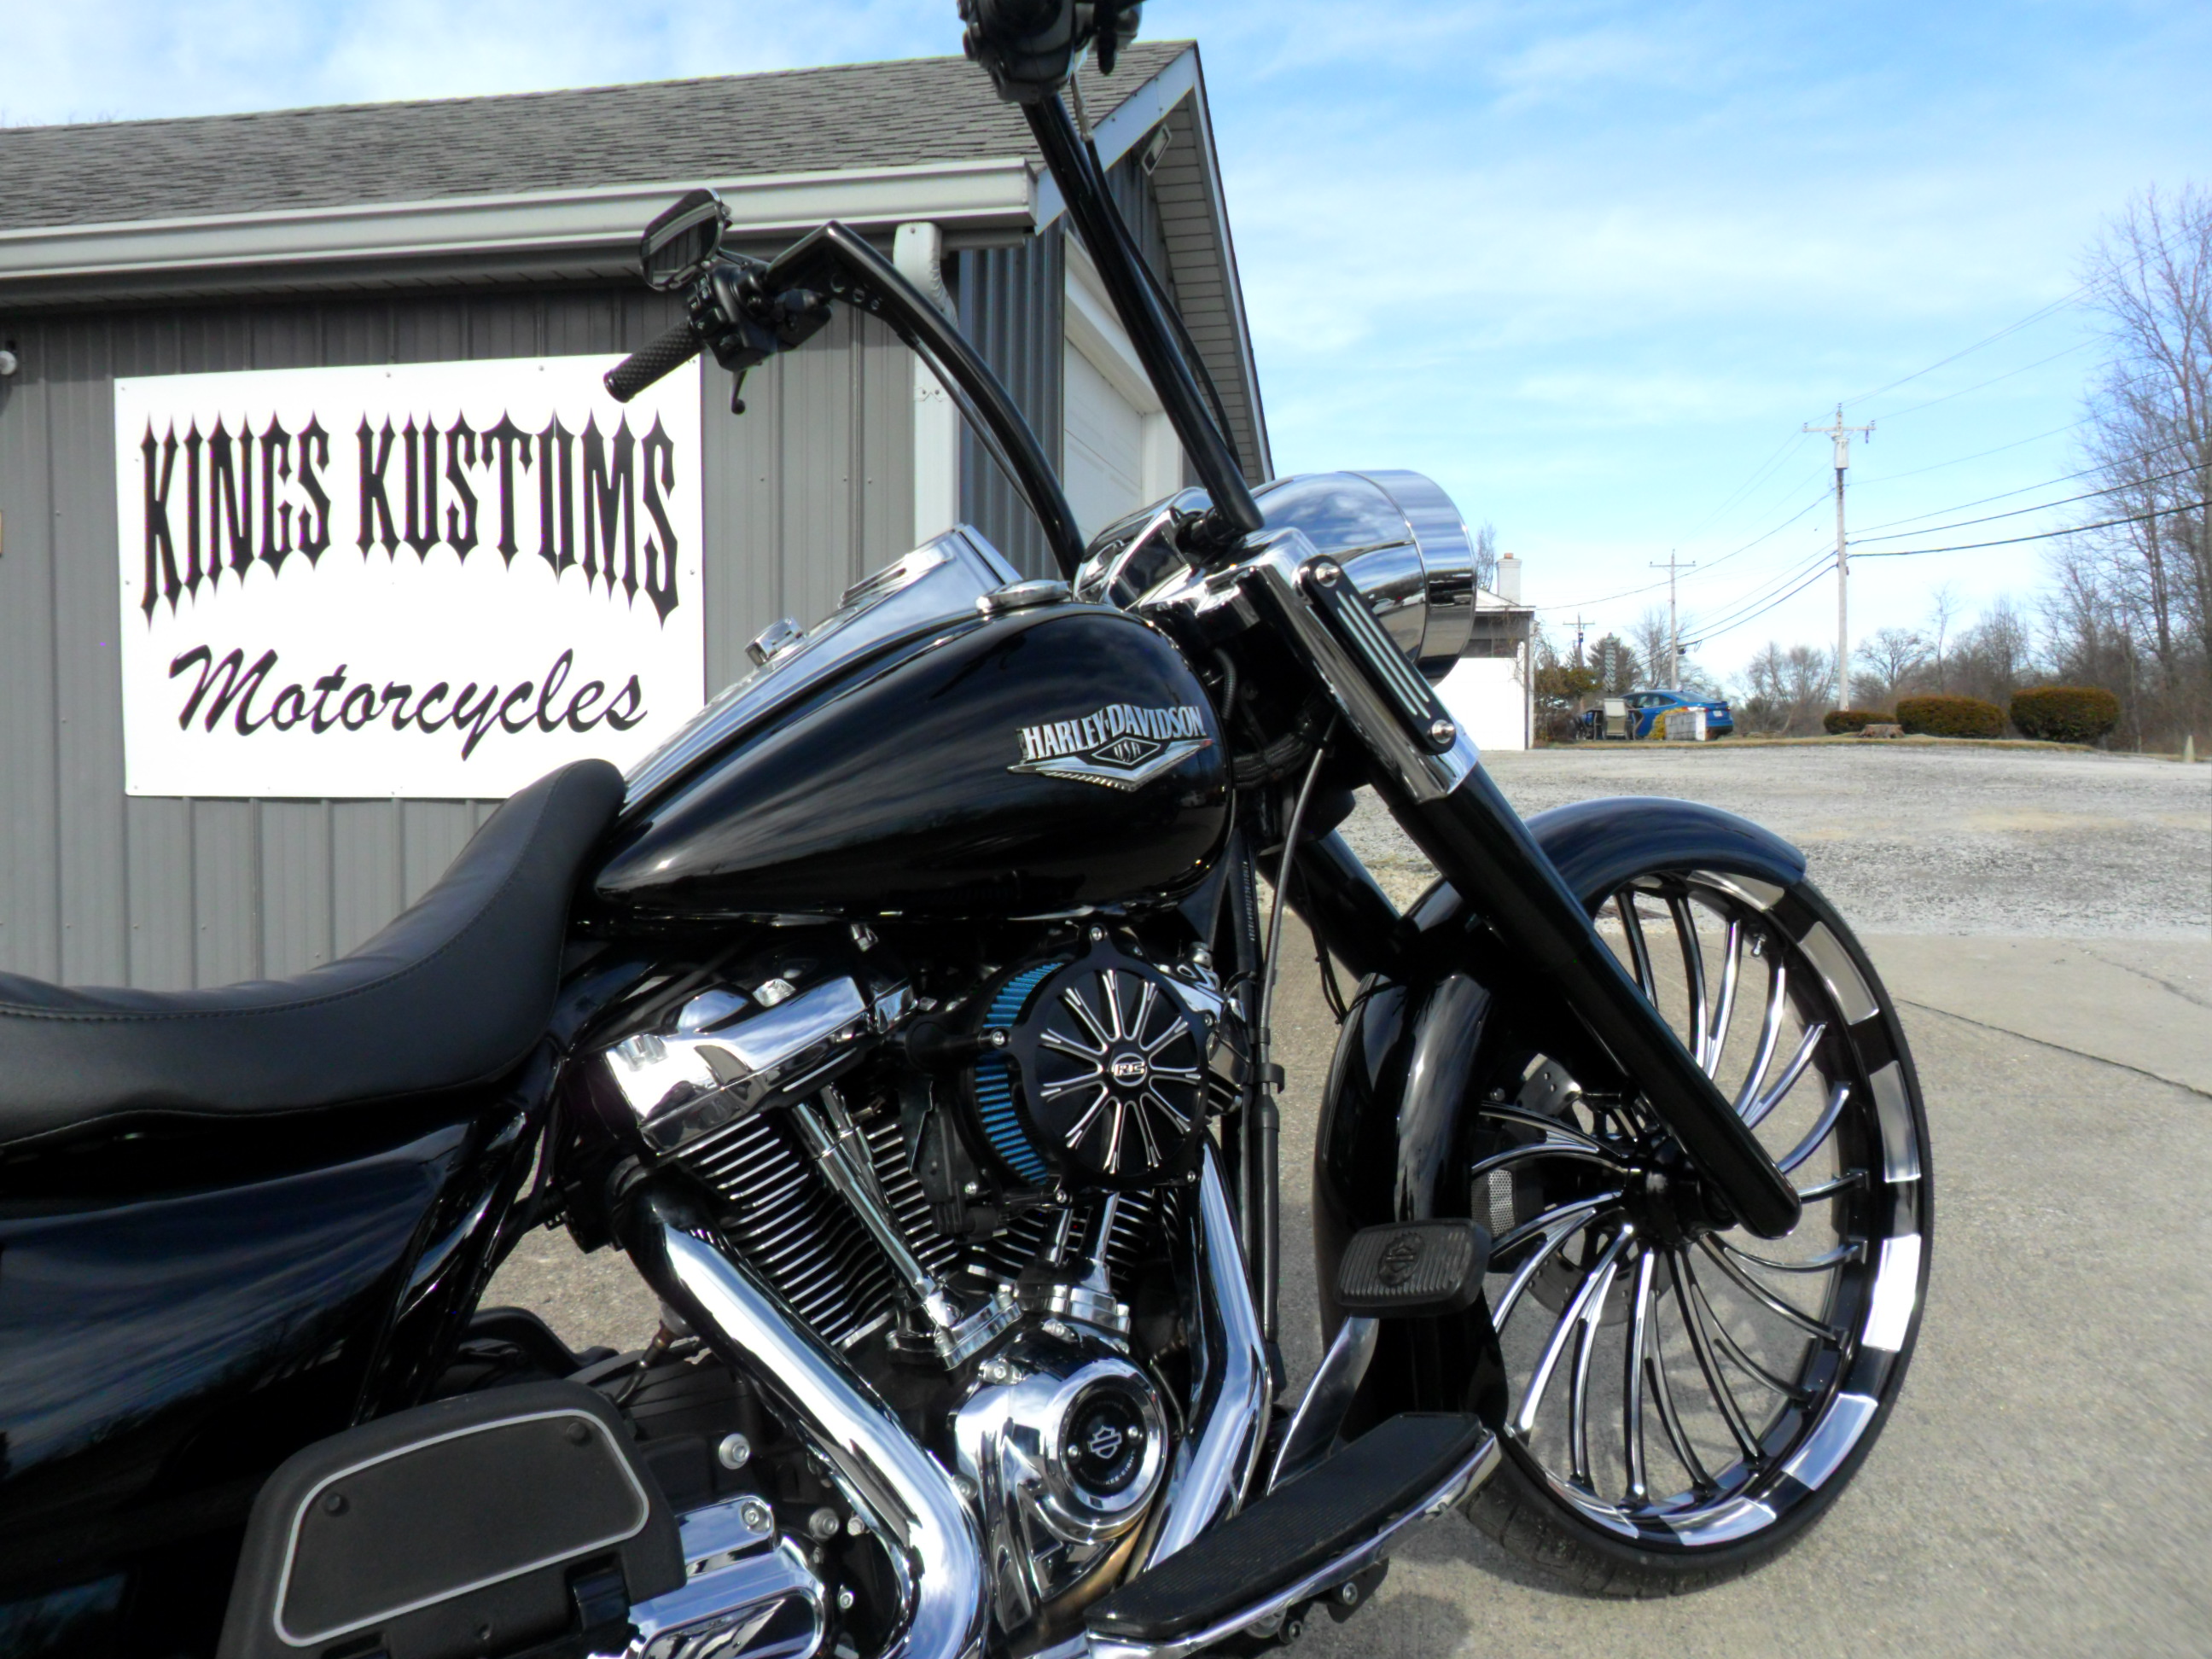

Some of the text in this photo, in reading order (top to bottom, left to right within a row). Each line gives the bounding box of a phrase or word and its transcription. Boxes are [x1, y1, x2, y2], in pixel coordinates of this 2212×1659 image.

[141, 407, 679, 632] KINGS KUSTOMS
[169, 644, 648, 761] Motorcycles
[1114, 741, 1141, 762] USA
